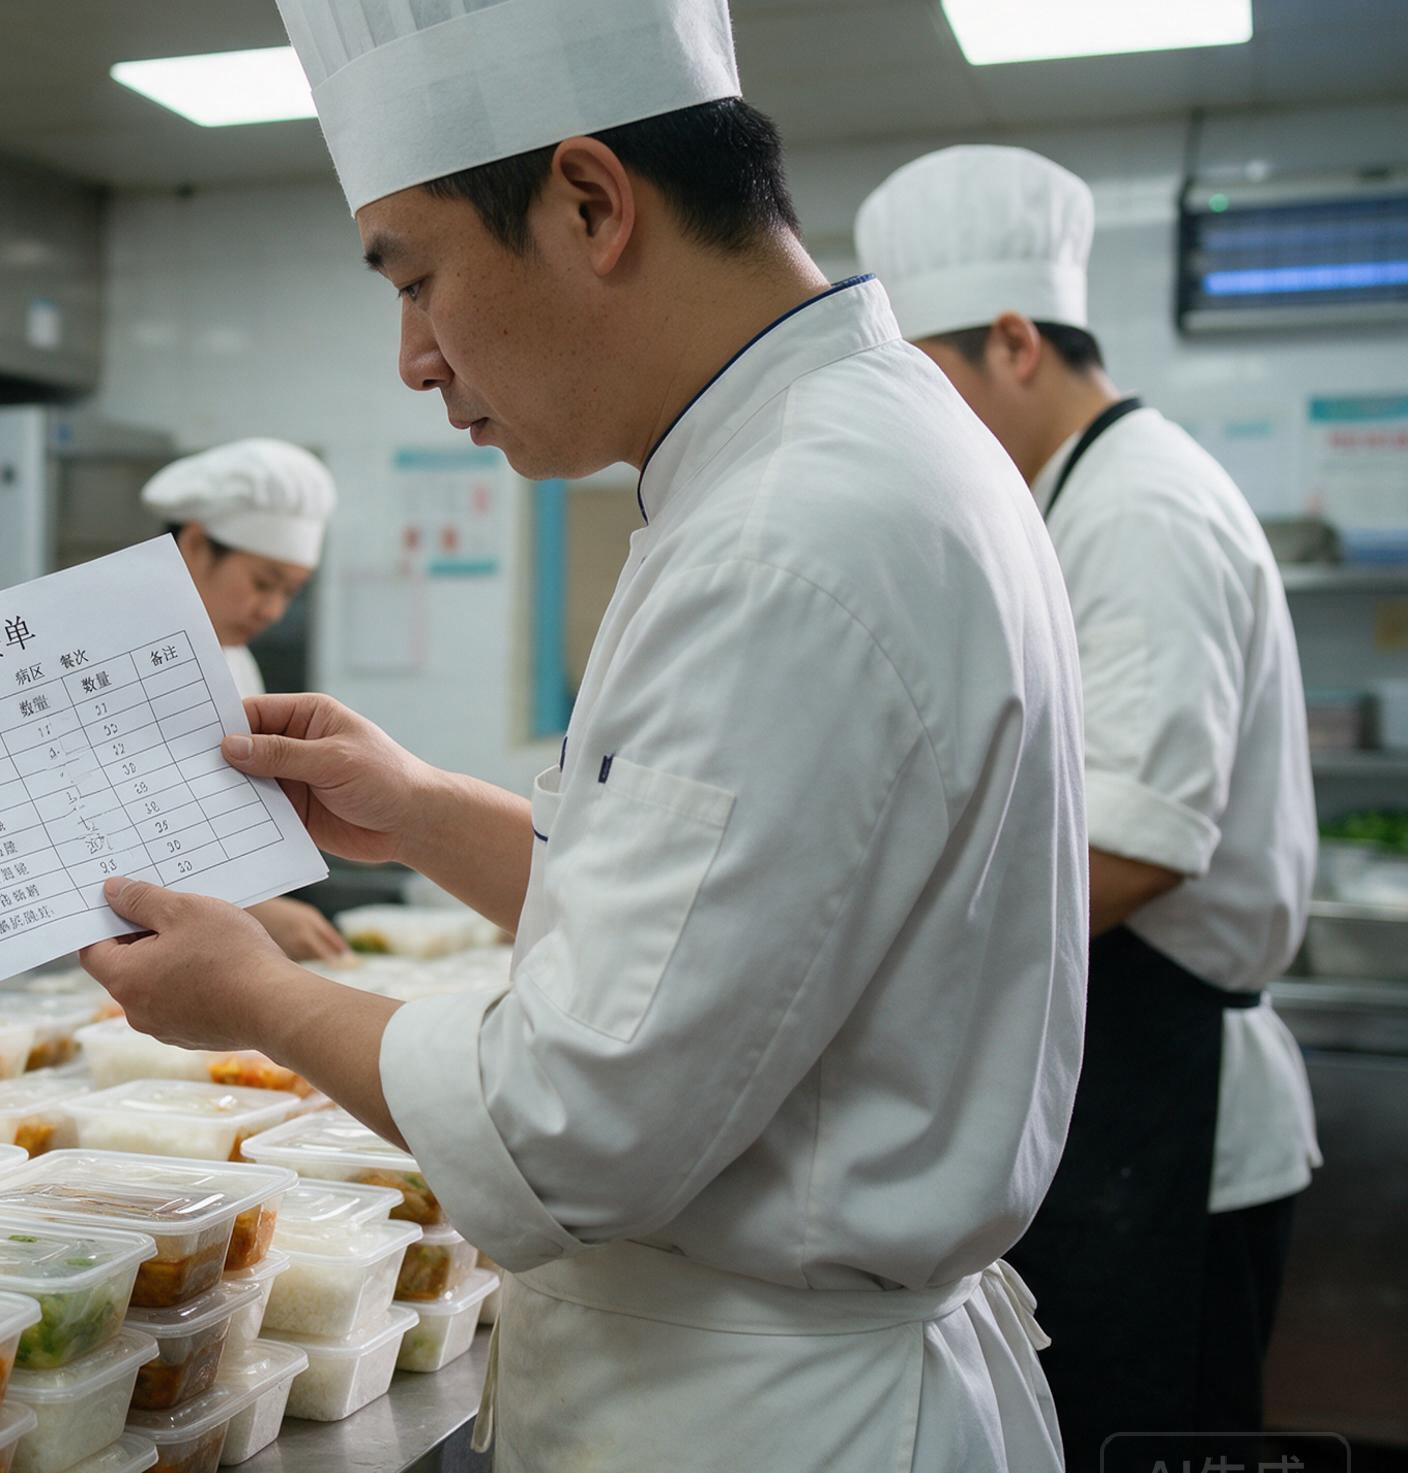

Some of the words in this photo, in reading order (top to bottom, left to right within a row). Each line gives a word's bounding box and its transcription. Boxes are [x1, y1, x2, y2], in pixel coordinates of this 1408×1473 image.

[15, 662, 45, 685] 病区
[59, 649, 89, 670] 餐次
[81, 671, 112, 694] 数量
[149, 645, 178, 667] 备注
